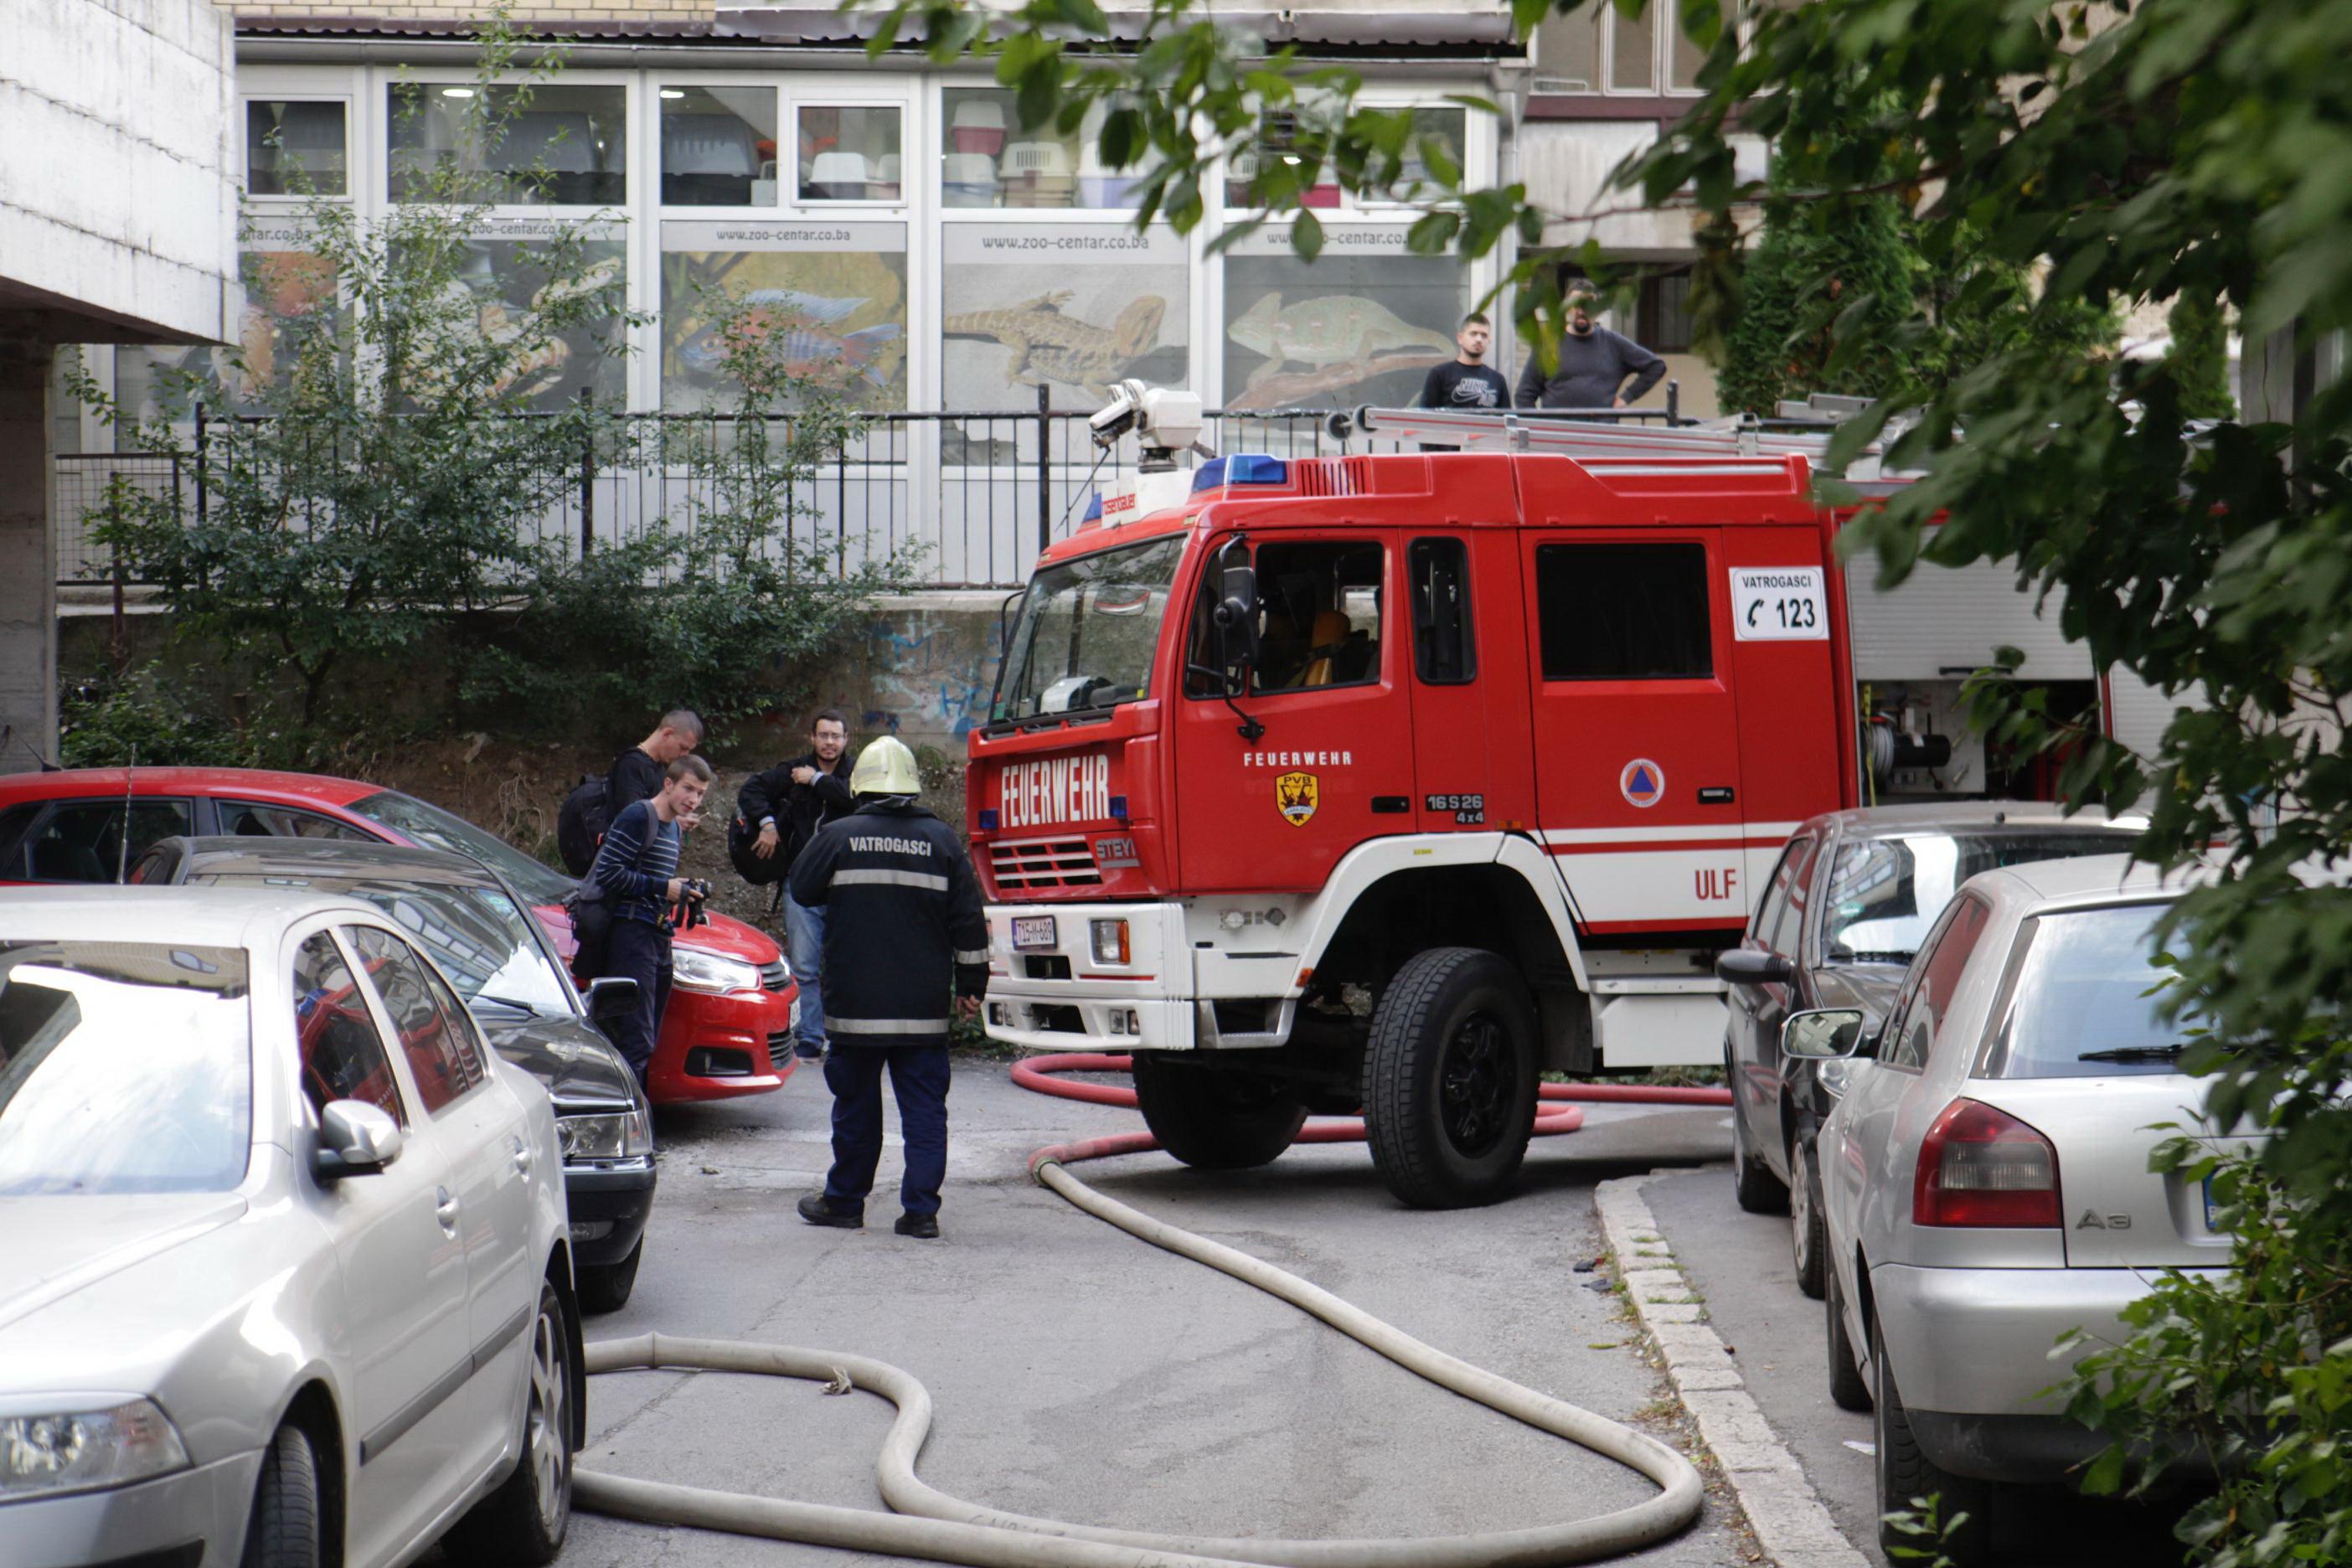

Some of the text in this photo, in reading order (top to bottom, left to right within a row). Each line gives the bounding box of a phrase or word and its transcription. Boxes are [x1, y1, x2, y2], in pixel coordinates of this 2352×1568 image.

[717, 229, 850, 241] www.zoo-centar.co.ba
[983, 235, 1149, 250] www.zoo-centar.co.ba
[1742, 575, 1812, 588] VATROGASCI
[1776, 598, 1816, 628] 123
[1243, 750, 1352, 766] FEUERWEHR
[1283, 776, 1312, 785] PVB
[1002, 754, 1110, 828] FEUERWEHR
[1428, 795, 1483, 810] 16 S 26
[848, 836, 932, 857] VATROGASCI
[1695, 868, 1736, 900] ULF
[2076, 1209, 2132, 1230] A3
